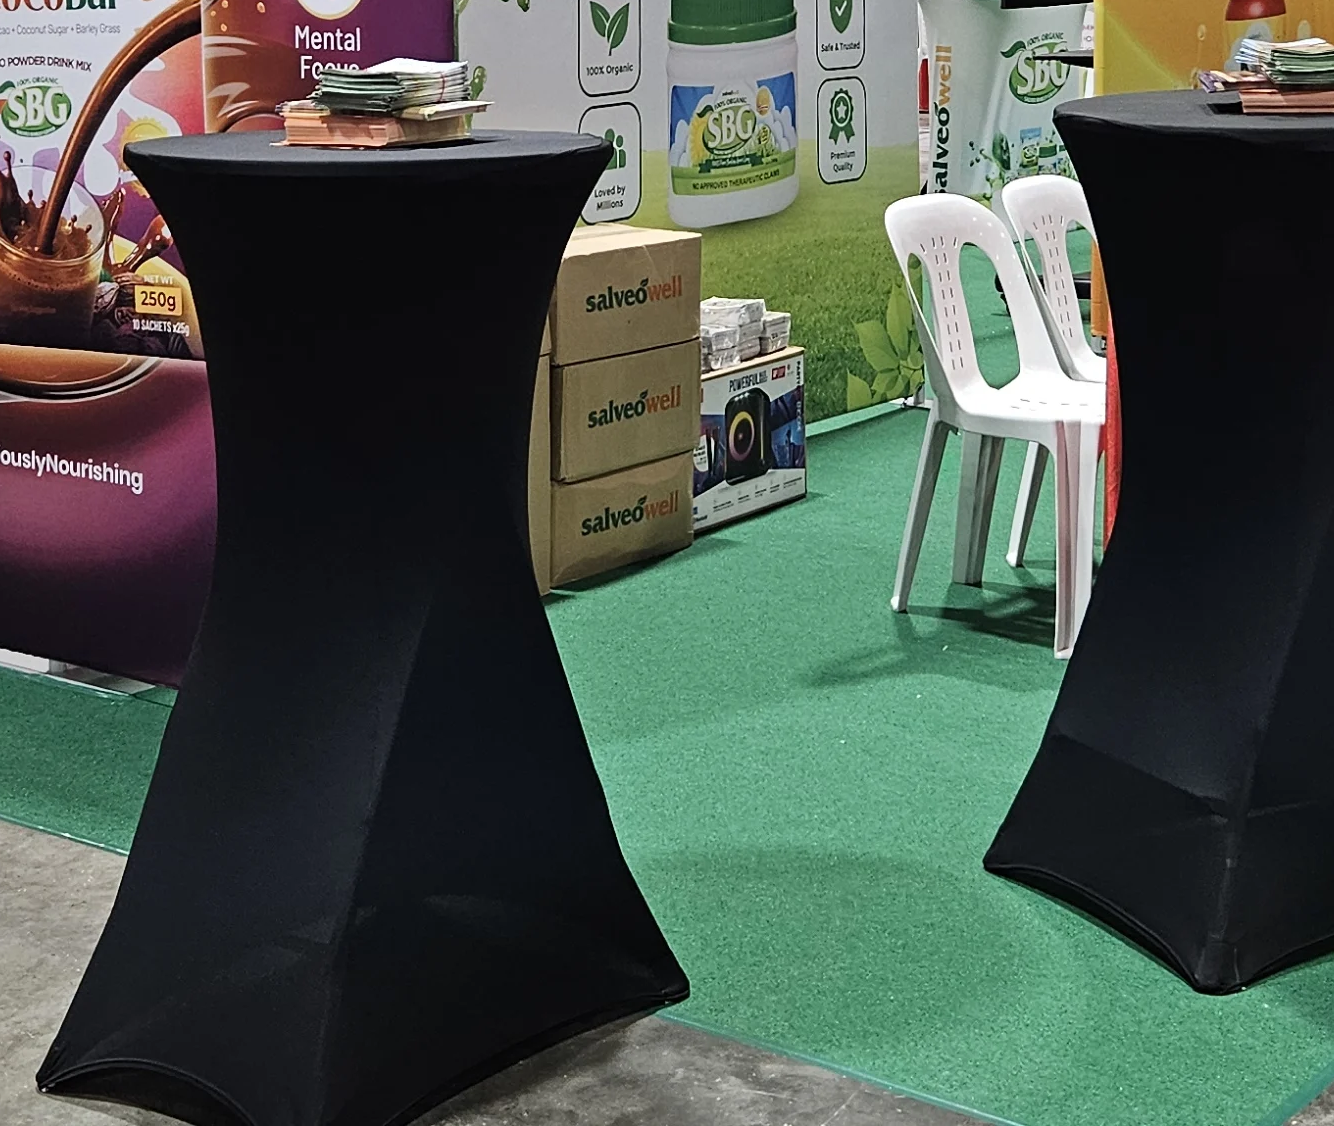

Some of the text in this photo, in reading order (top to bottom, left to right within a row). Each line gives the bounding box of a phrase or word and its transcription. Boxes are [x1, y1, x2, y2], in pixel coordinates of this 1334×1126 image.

[17, 25, 46, 35] Coconut
[47, 25, 67, 36] Sugar
[76, 24, 98, 36] Barley
[100, 24, 121, 34] Grass
[295, 25, 361, 52] Mental
[821, 41, 860, 52] Safe Trusted
[8, 56, 46, 66] POWDER
[48, 57, 74, 69] DRINK
[76, 60, 92, 72] MIX
[586, 63, 633, 76] 100% Organic
[7, 86, 67, 129] SBG
[707, 104, 753, 149] SBG
[831, 150, 855, 160] Premium
[833, 162, 853, 173] Quality
[594, 185, 625, 198] Loved by
[141, 291, 176, 312] 250g
[585, 274, 683, 313] salveowell
[133, 319, 171, 332] 10 SACHETS
[587, 384, 682, 429] salveowell
[581, 490, 679, 537] salveowell
